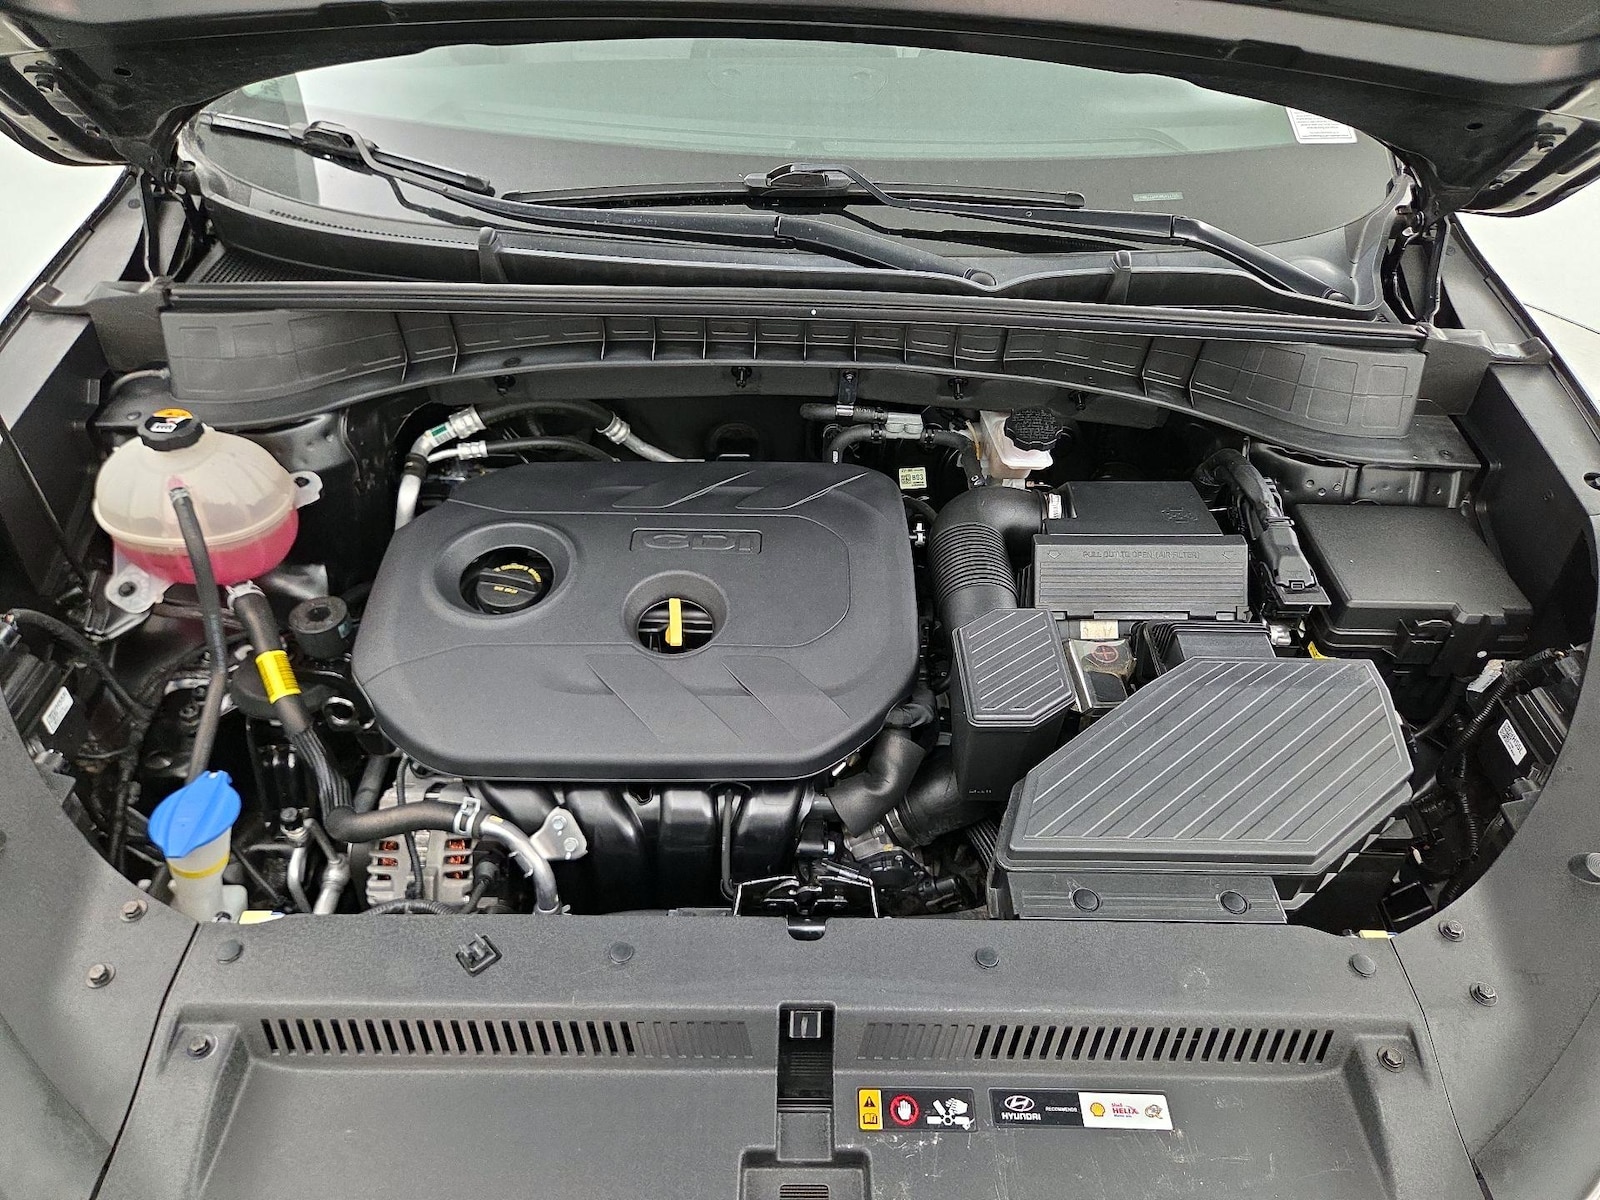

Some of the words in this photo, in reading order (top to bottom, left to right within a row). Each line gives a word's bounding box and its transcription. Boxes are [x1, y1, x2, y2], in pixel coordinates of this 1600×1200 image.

[643, 534, 752, 551] GDI
[1132, 551, 1153, 559] OPEN
[1001, 1112, 1041, 1121] HYUNDAI
